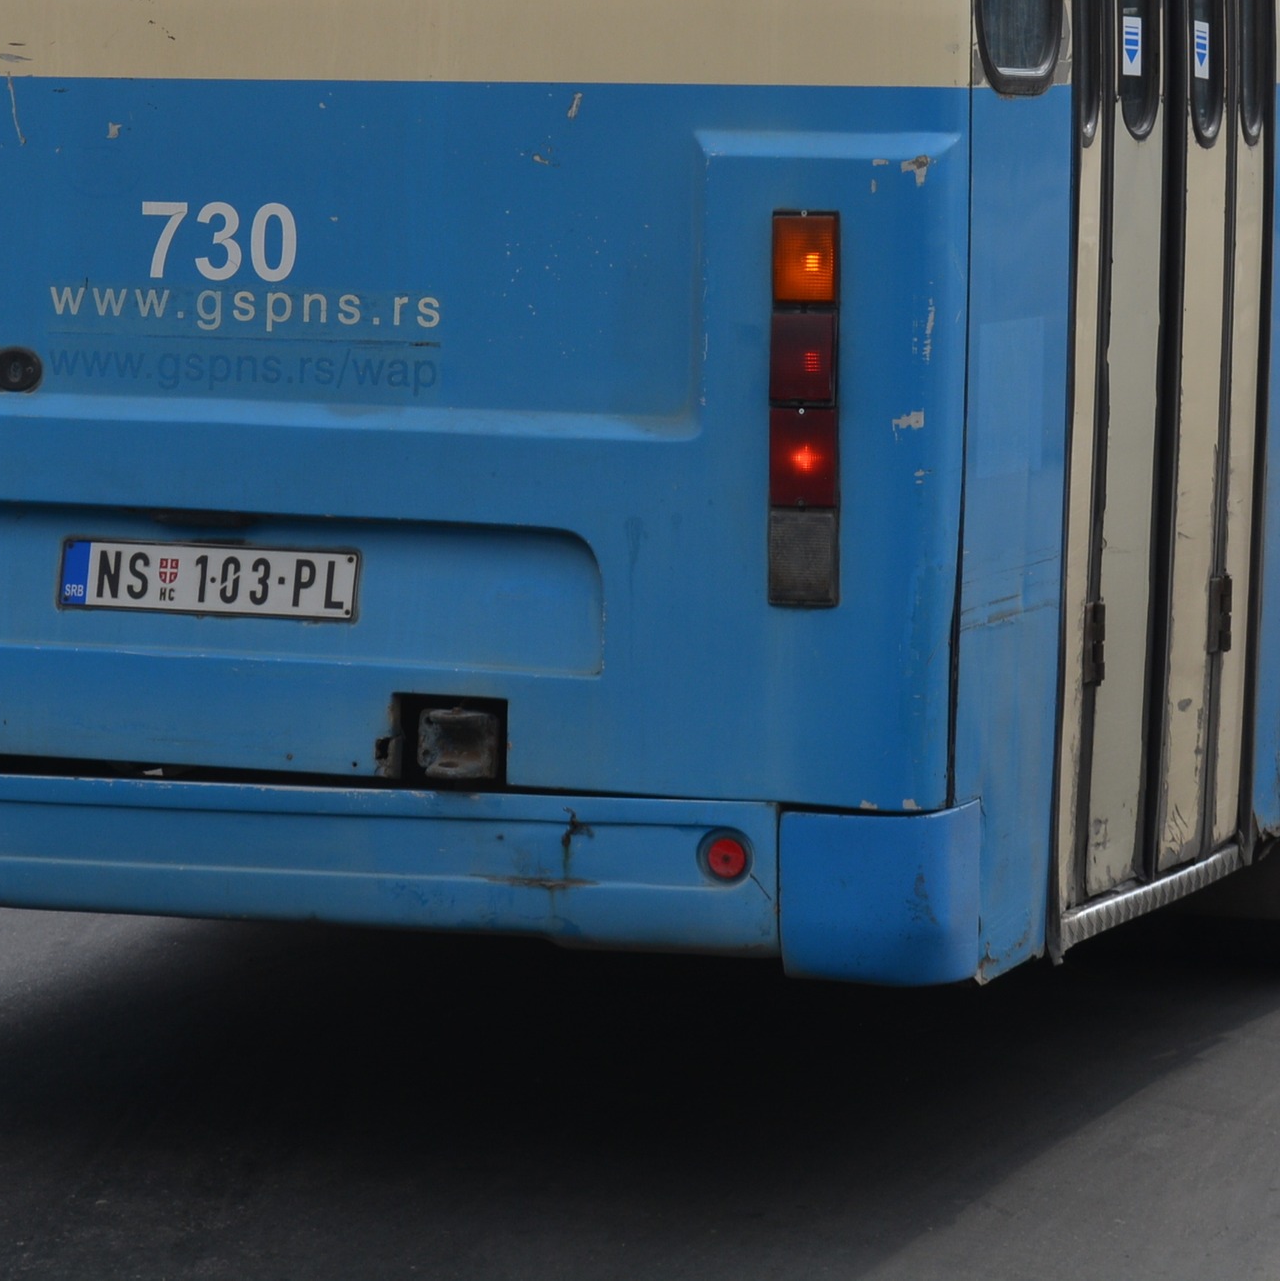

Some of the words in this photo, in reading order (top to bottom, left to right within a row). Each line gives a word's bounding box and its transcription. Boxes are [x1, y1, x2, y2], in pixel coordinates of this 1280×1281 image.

[141, 201, 298, 282] 730
[50, 286, 441, 332] www.gspns.rs
[49, 348, 438, 396] www.gspns.rs/wap
[65, 584, 84, 597] SRB
[96, 550, 150, 600] NS
